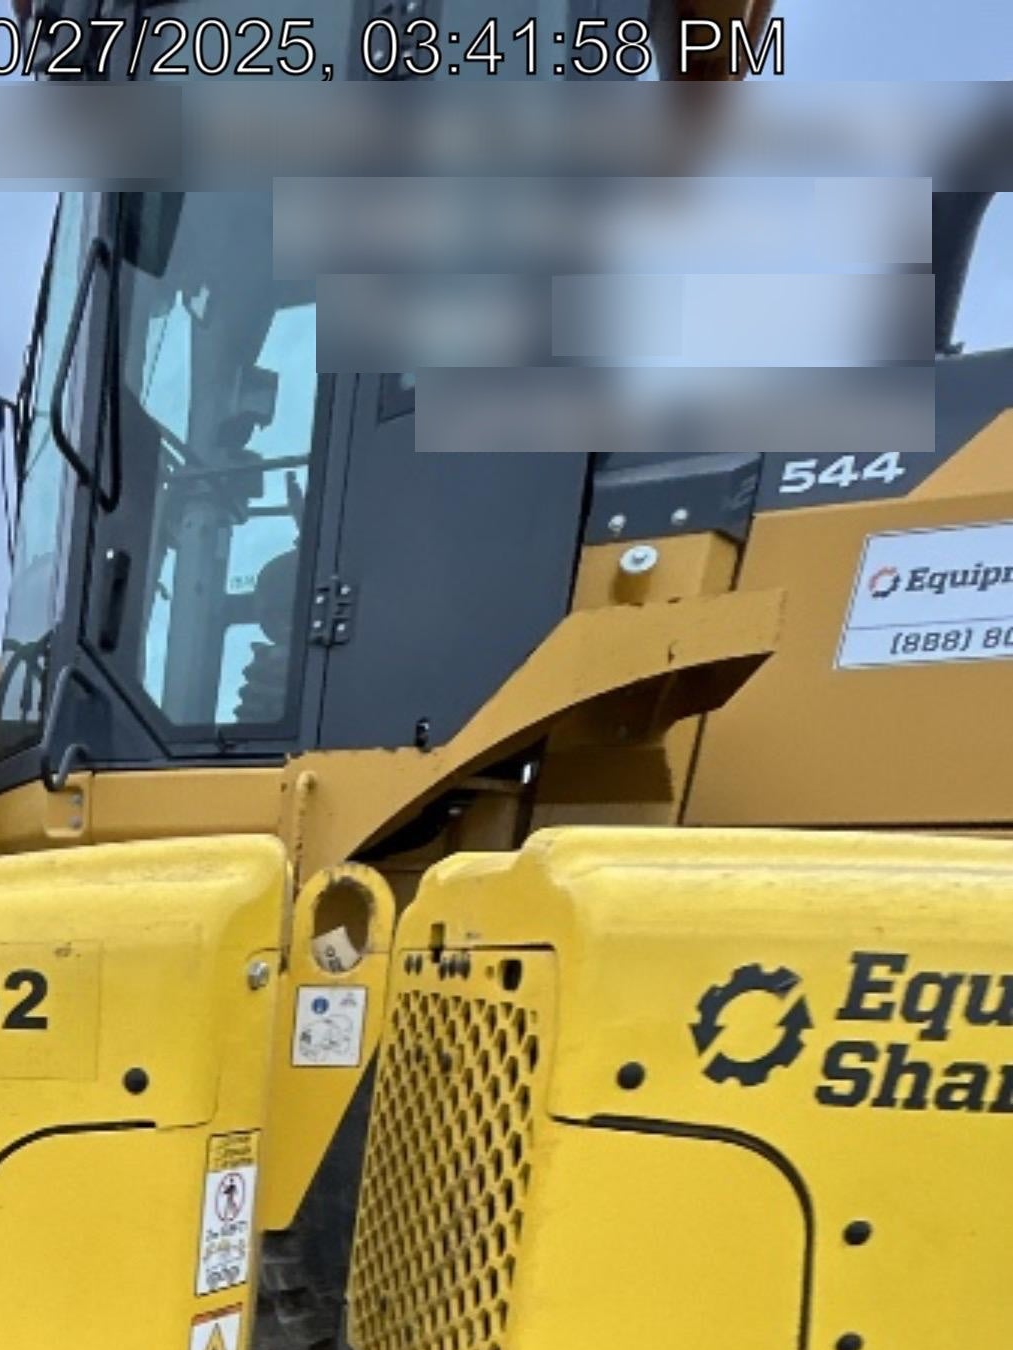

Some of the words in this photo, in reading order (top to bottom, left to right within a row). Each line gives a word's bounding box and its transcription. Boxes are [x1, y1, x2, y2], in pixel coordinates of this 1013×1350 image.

[779, 451, 906, 493] 544
[890, 627, 973, 655] (888)
[835, 951, 1013, 1041] Equ
